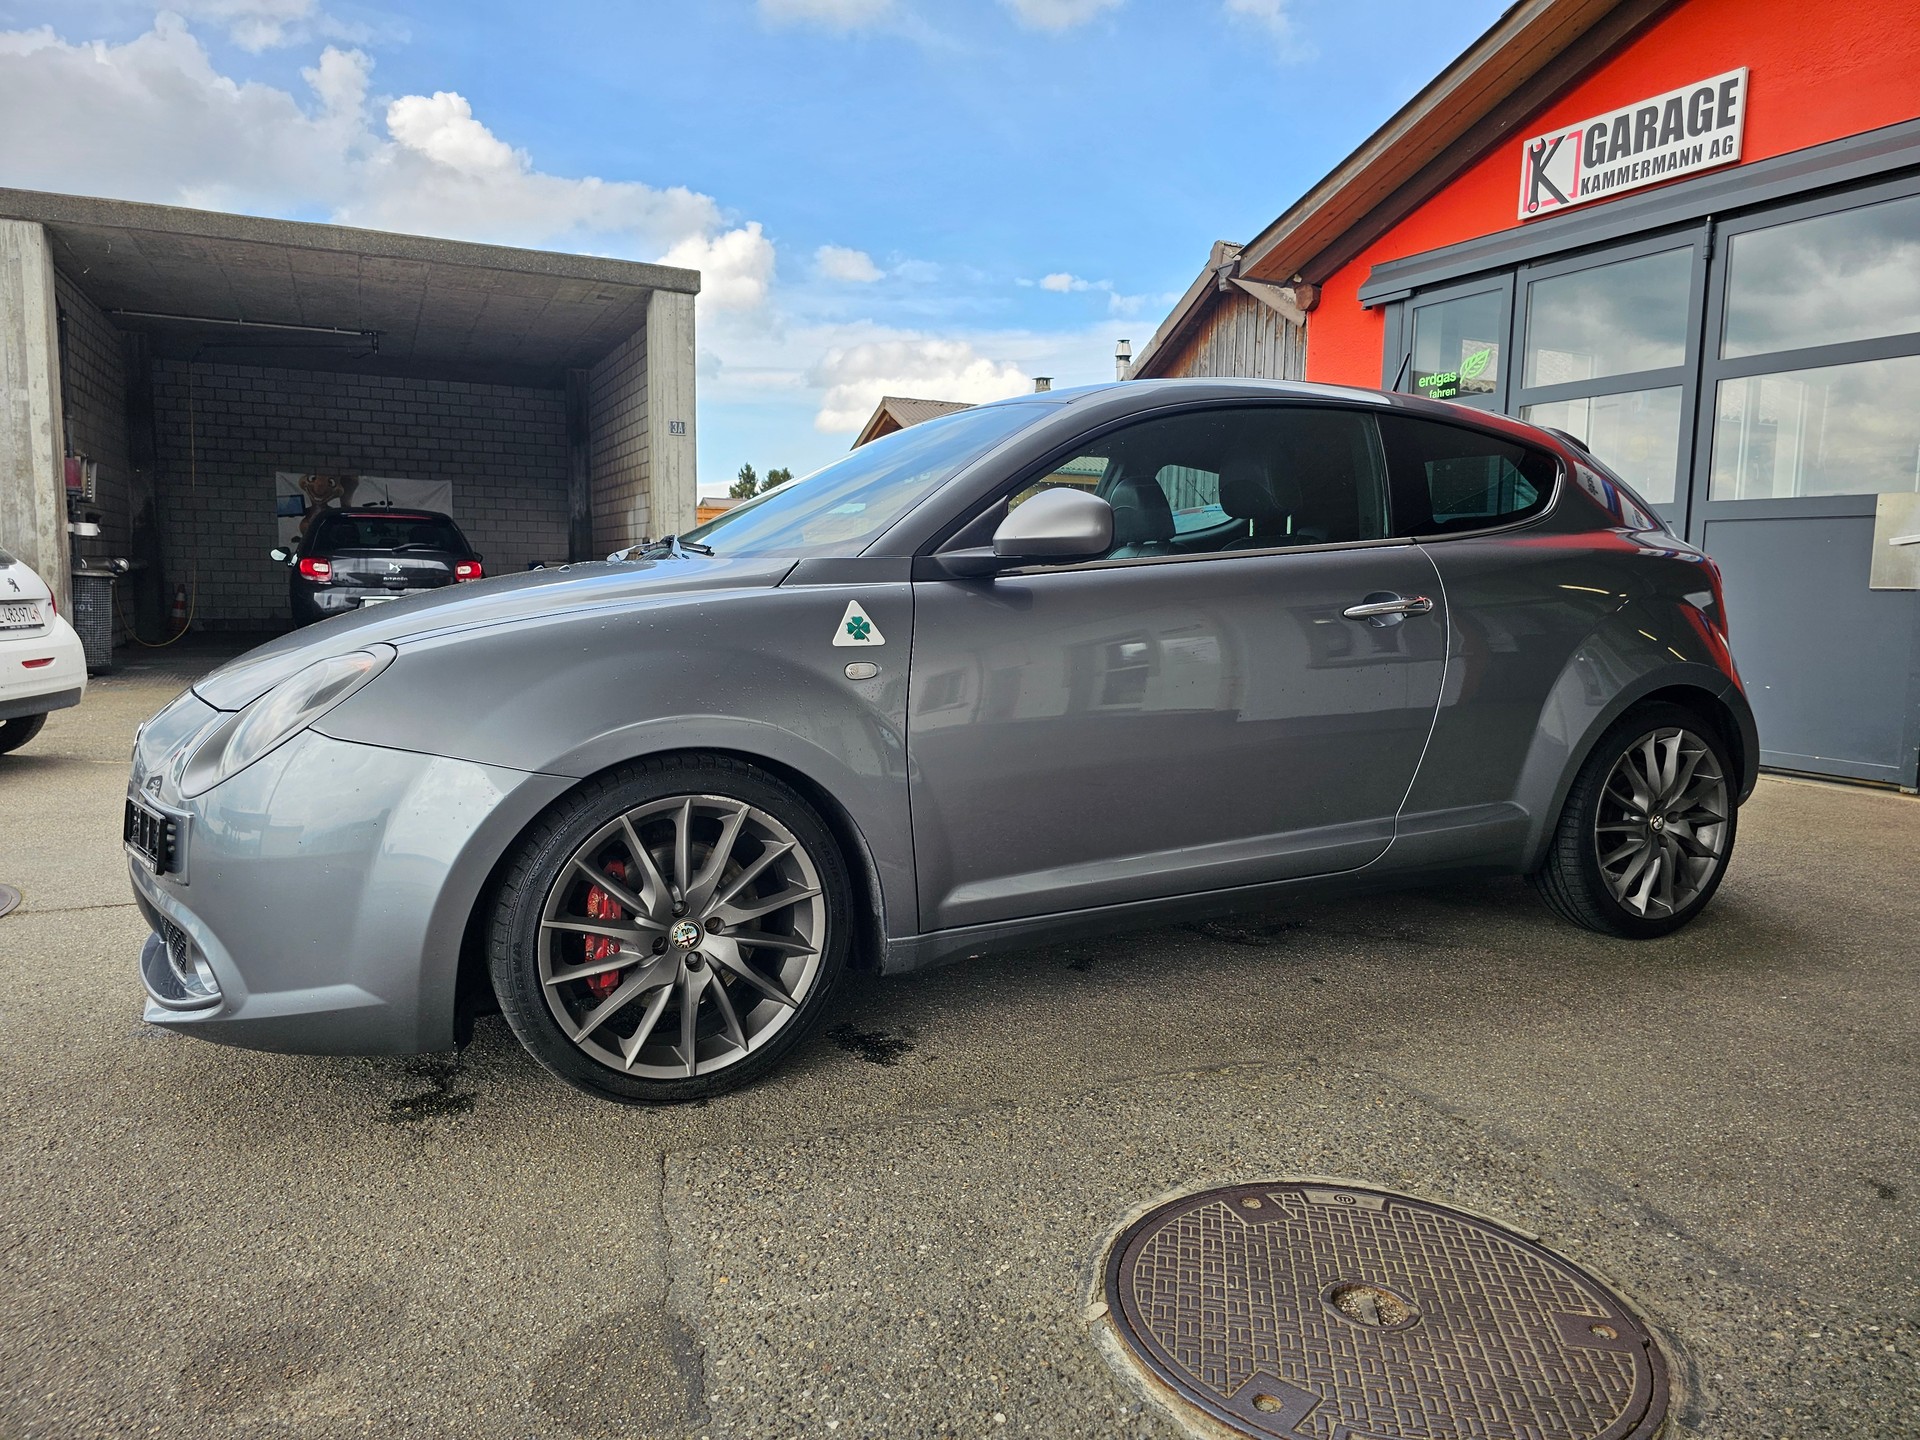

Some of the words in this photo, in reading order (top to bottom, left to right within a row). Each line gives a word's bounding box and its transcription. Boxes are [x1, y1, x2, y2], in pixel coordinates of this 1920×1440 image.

[1583, 77, 1739, 169] GARAGE
[1580, 144, 1703, 196] KAMMERMANN
[1708, 135, 1734, 160] AG
[1419, 371, 1457, 387] erdgas
[1429, 387, 1456, 399] fahren
[672, 422, 684, 434] 3A
